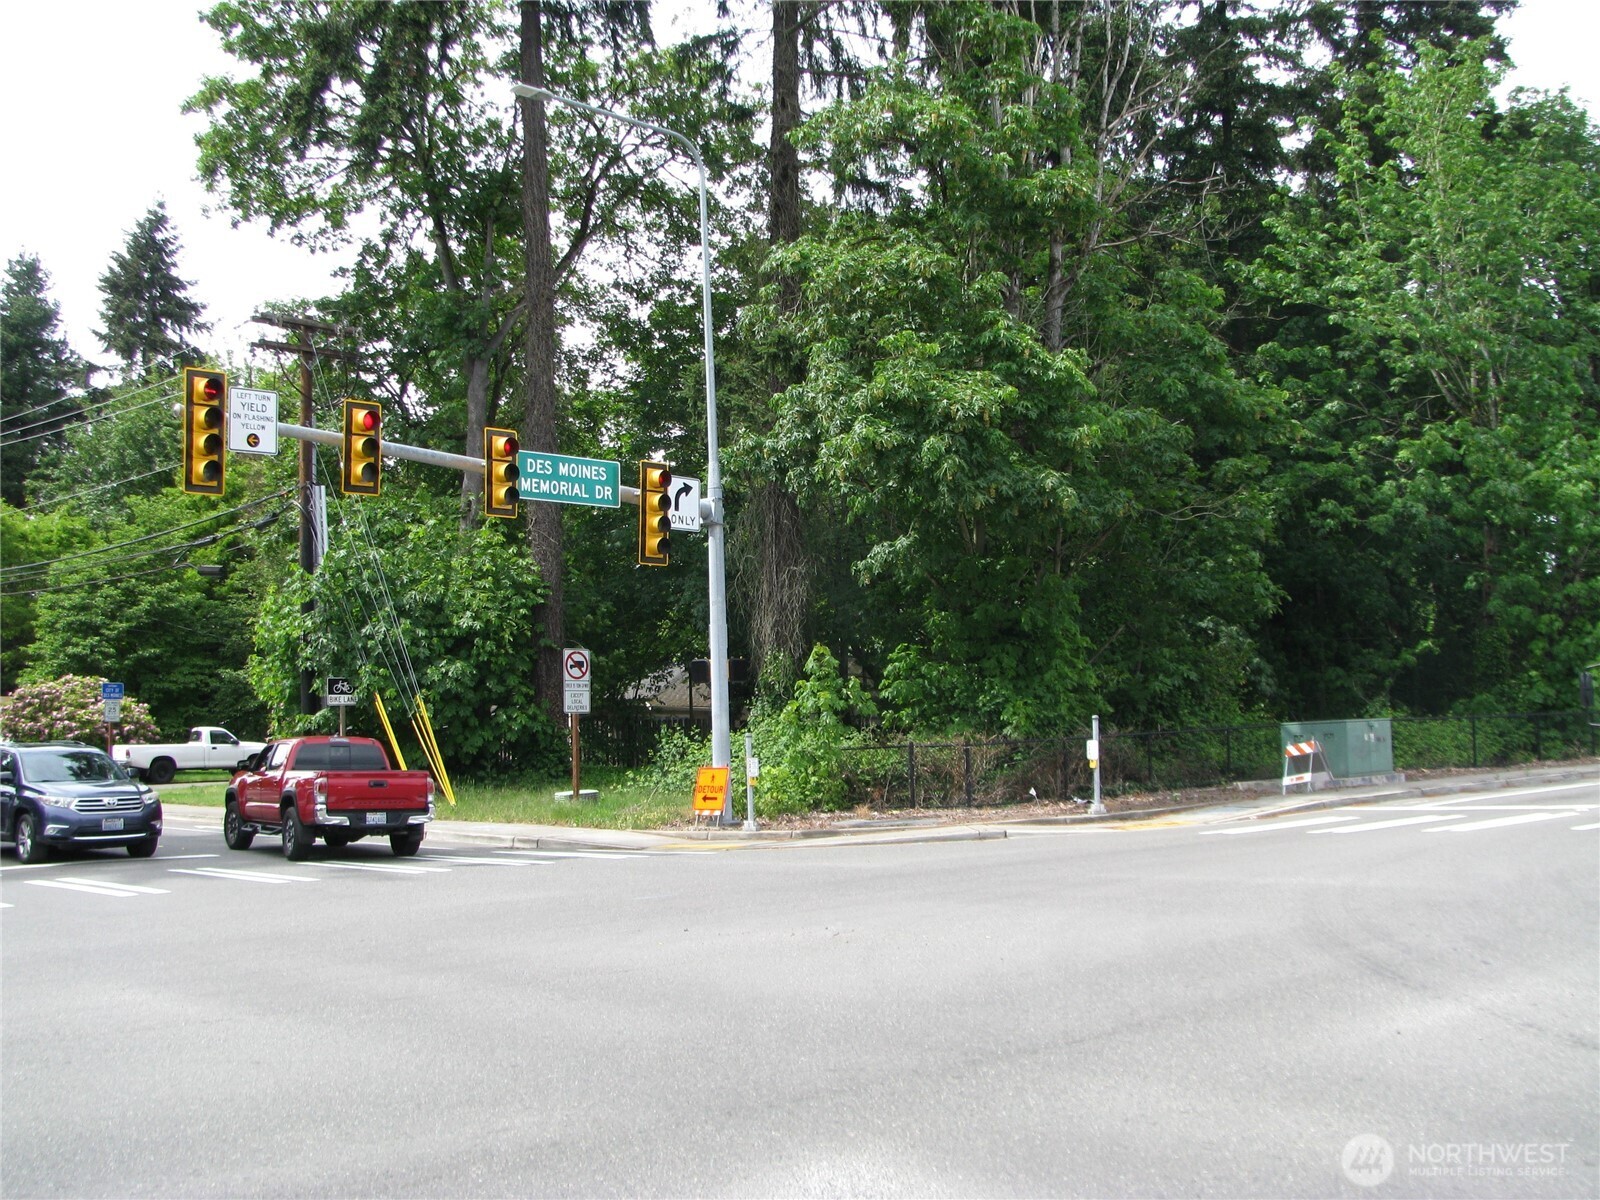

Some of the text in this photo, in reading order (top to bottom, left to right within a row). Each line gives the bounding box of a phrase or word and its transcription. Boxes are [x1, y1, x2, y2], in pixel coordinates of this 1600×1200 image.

[254, 394, 271, 402] TURN
[240, 402, 268, 412] YIELD
[244, 414, 274, 422] FLASHING
[241, 422, 266, 430] YELLOW
[527, 458, 607, 480] DES MOINES
[521, 477, 613, 500] MEMORIAL DR
[671, 514, 696, 526] ONLY
[698, 785, 724, 794] DETOUR
